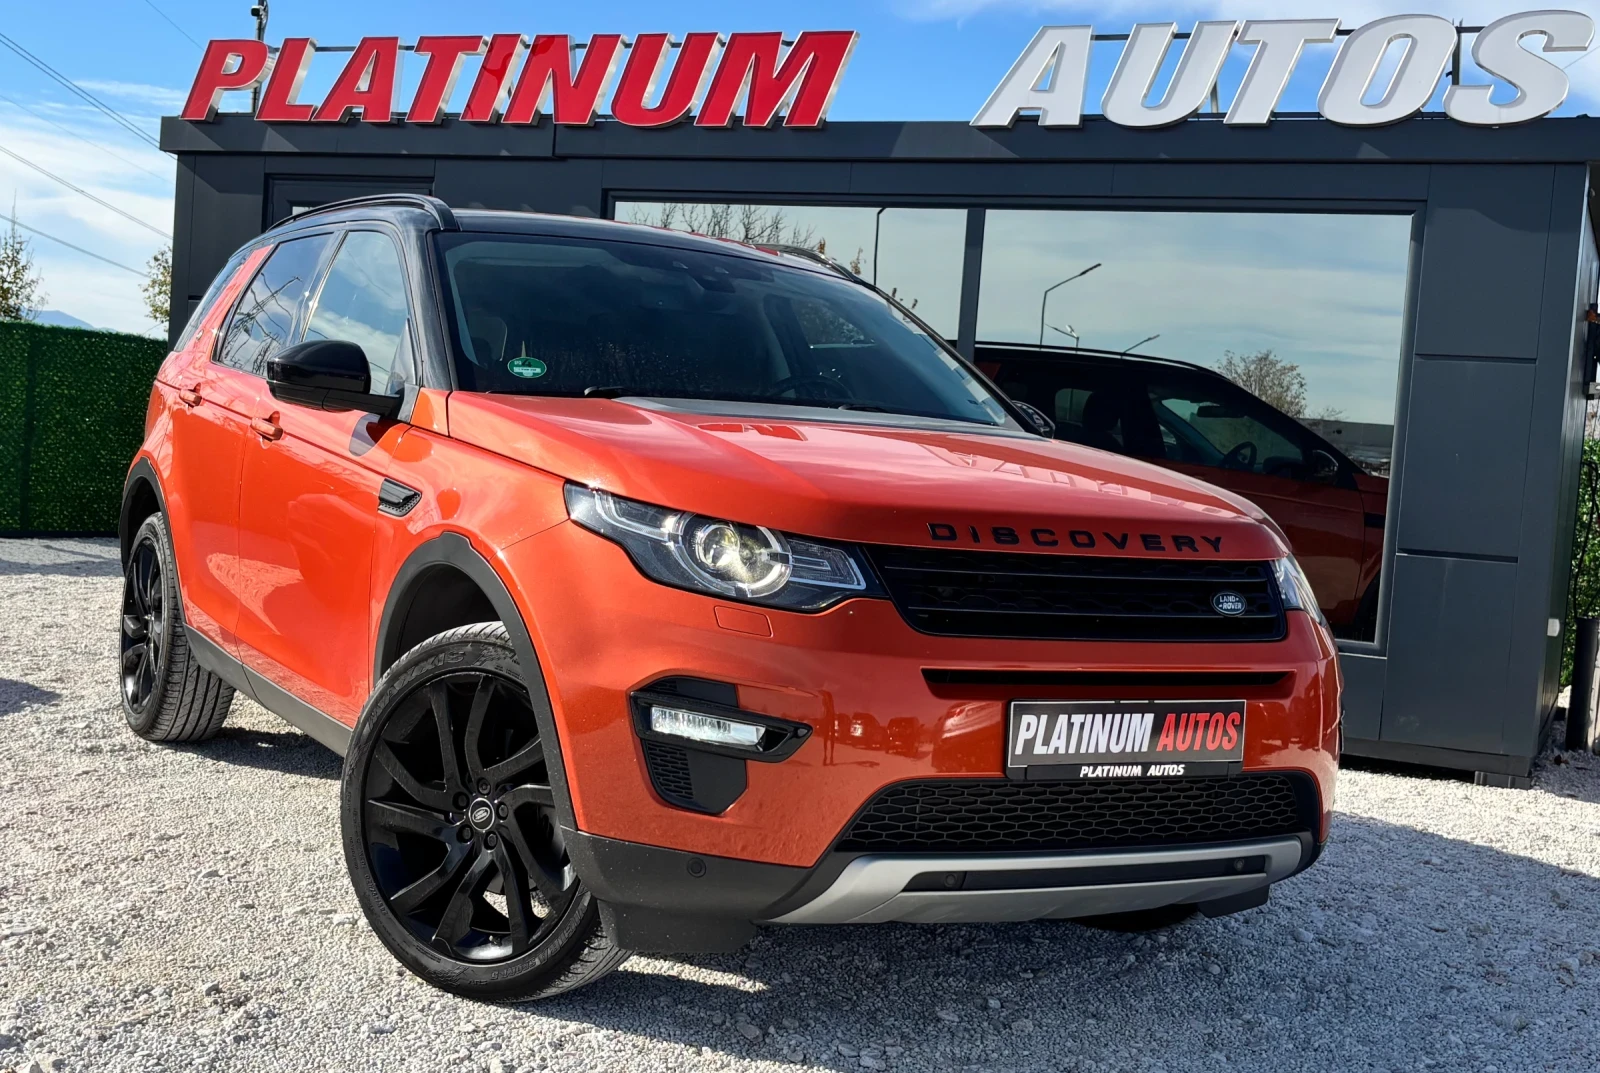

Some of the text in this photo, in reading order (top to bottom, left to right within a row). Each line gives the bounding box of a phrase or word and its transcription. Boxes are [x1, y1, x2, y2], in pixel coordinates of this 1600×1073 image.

[179, 9, 1596, 129] PLATINUM AUTOS
[926, 522, 1222, 553] DISCOVERY
[1219, 595, 1236, 603] LAND
[1222, 602, 1242, 610] ROVER
[367, 650, 465, 724] MAXXIS
[1014, 711, 1241, 755] PLATINUM AUTOS
[1079, 764, 1185, 778] PLATINUM AUTOS
